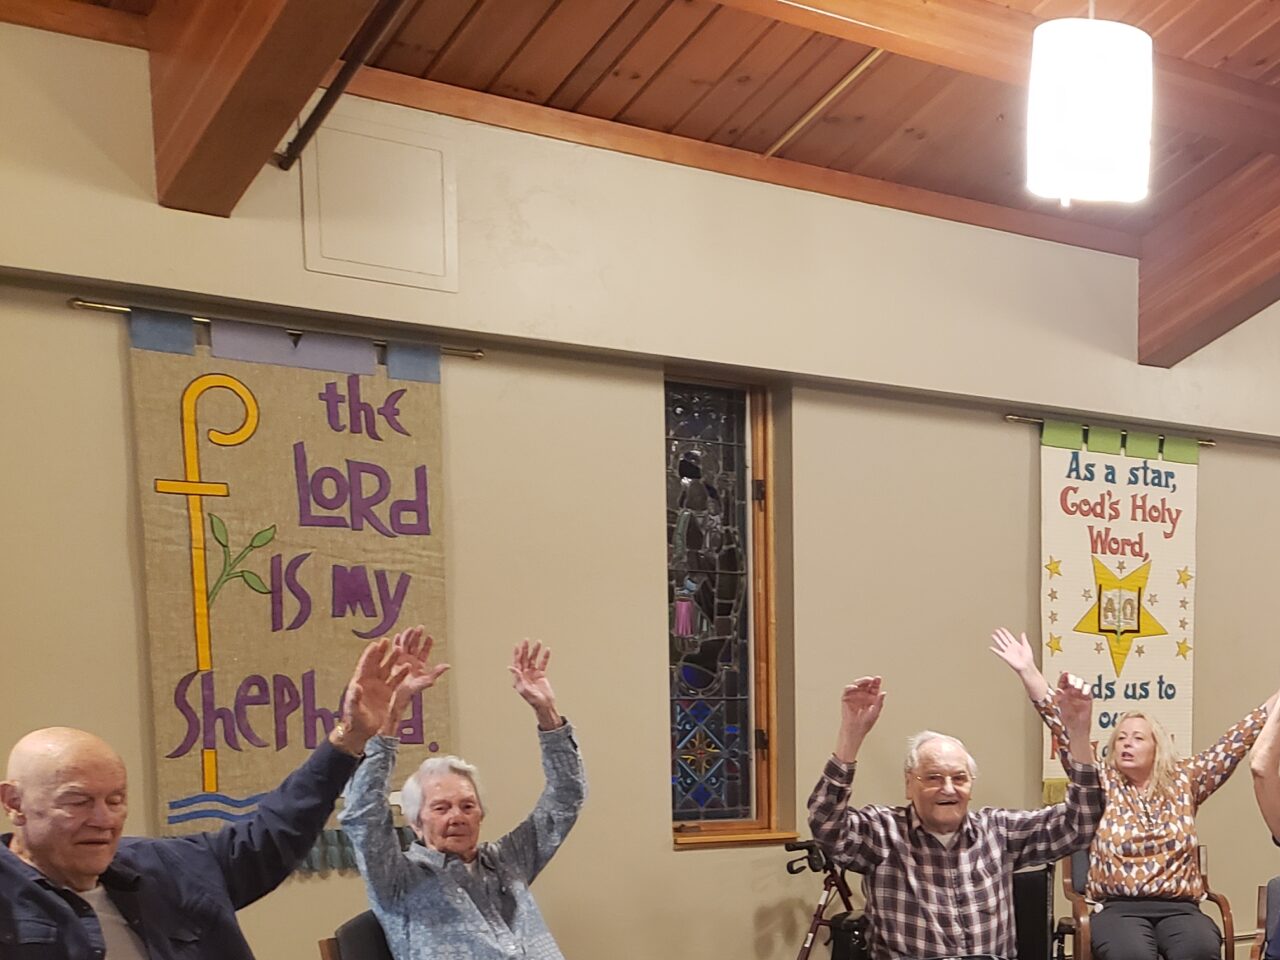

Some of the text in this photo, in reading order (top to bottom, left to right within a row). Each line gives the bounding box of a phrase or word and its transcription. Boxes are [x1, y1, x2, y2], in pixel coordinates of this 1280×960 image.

[319, 374, 411, 441] the
[1065, 451, 1177, 493] As a star,
[1060, 486, 1183, 539] God's Holy
[1087, 525, 1150, 562] Word,
[1124, 681, 1150, 700] us
[1157, 674, 1176, 699] to
